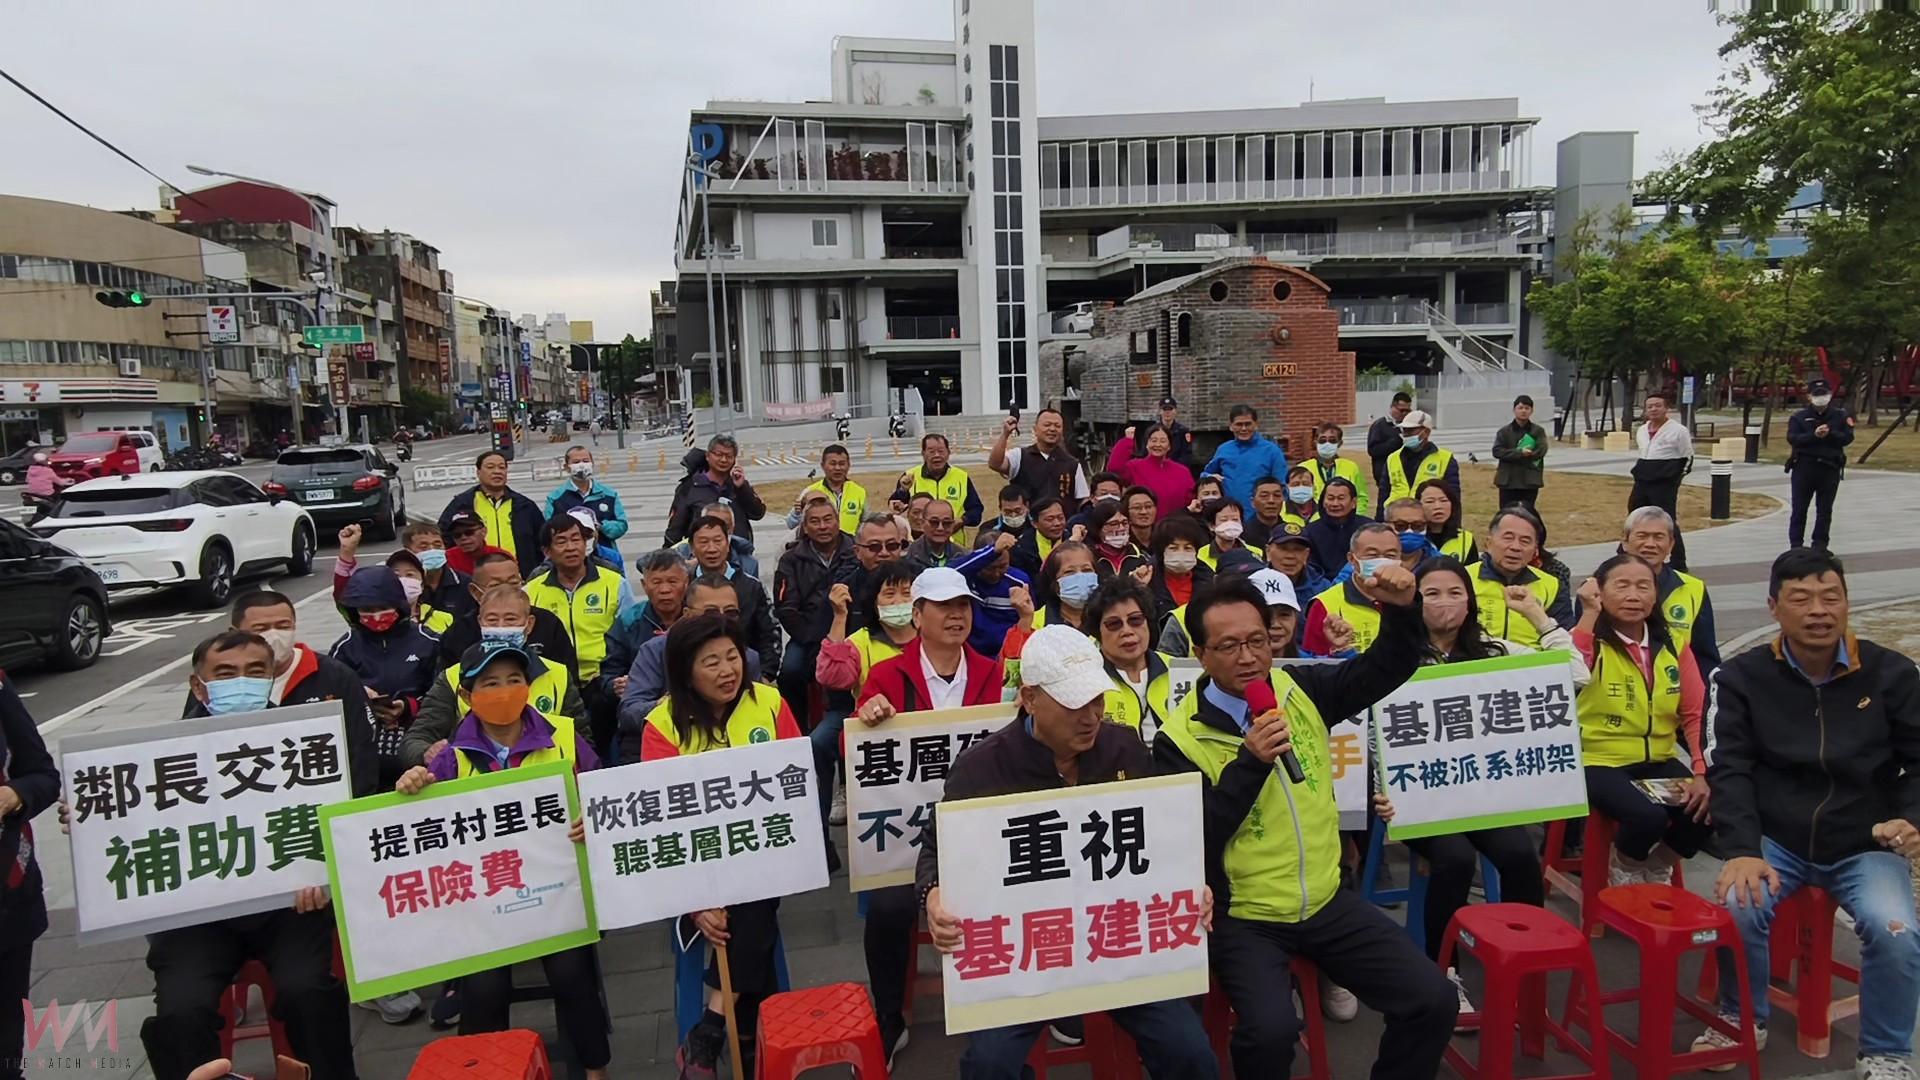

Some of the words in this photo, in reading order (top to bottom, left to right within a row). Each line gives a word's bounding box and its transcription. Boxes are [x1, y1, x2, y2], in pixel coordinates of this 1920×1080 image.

[1265, 364, 1296, 376] CK124
[1265, 579, 1281, 593] NY
[1382, 684, 1573, 748] 基層建設
[73, 732, 343, 824] 鄰長交通
[586, 763, 810, 834] 恢復里民大會
[1387, 743, 1577, 793] 不被派系綁架
[105, 803, 326, 901] 補助費
[368, 793, 567, 863] 提高村里長
[612, 812, 797, 876] 聽基層民意
[1001, 806, 1150, 887] 重視
[378, 848, 527, 919] 保險費
[952, 889, 1202, 981] 基層建設
